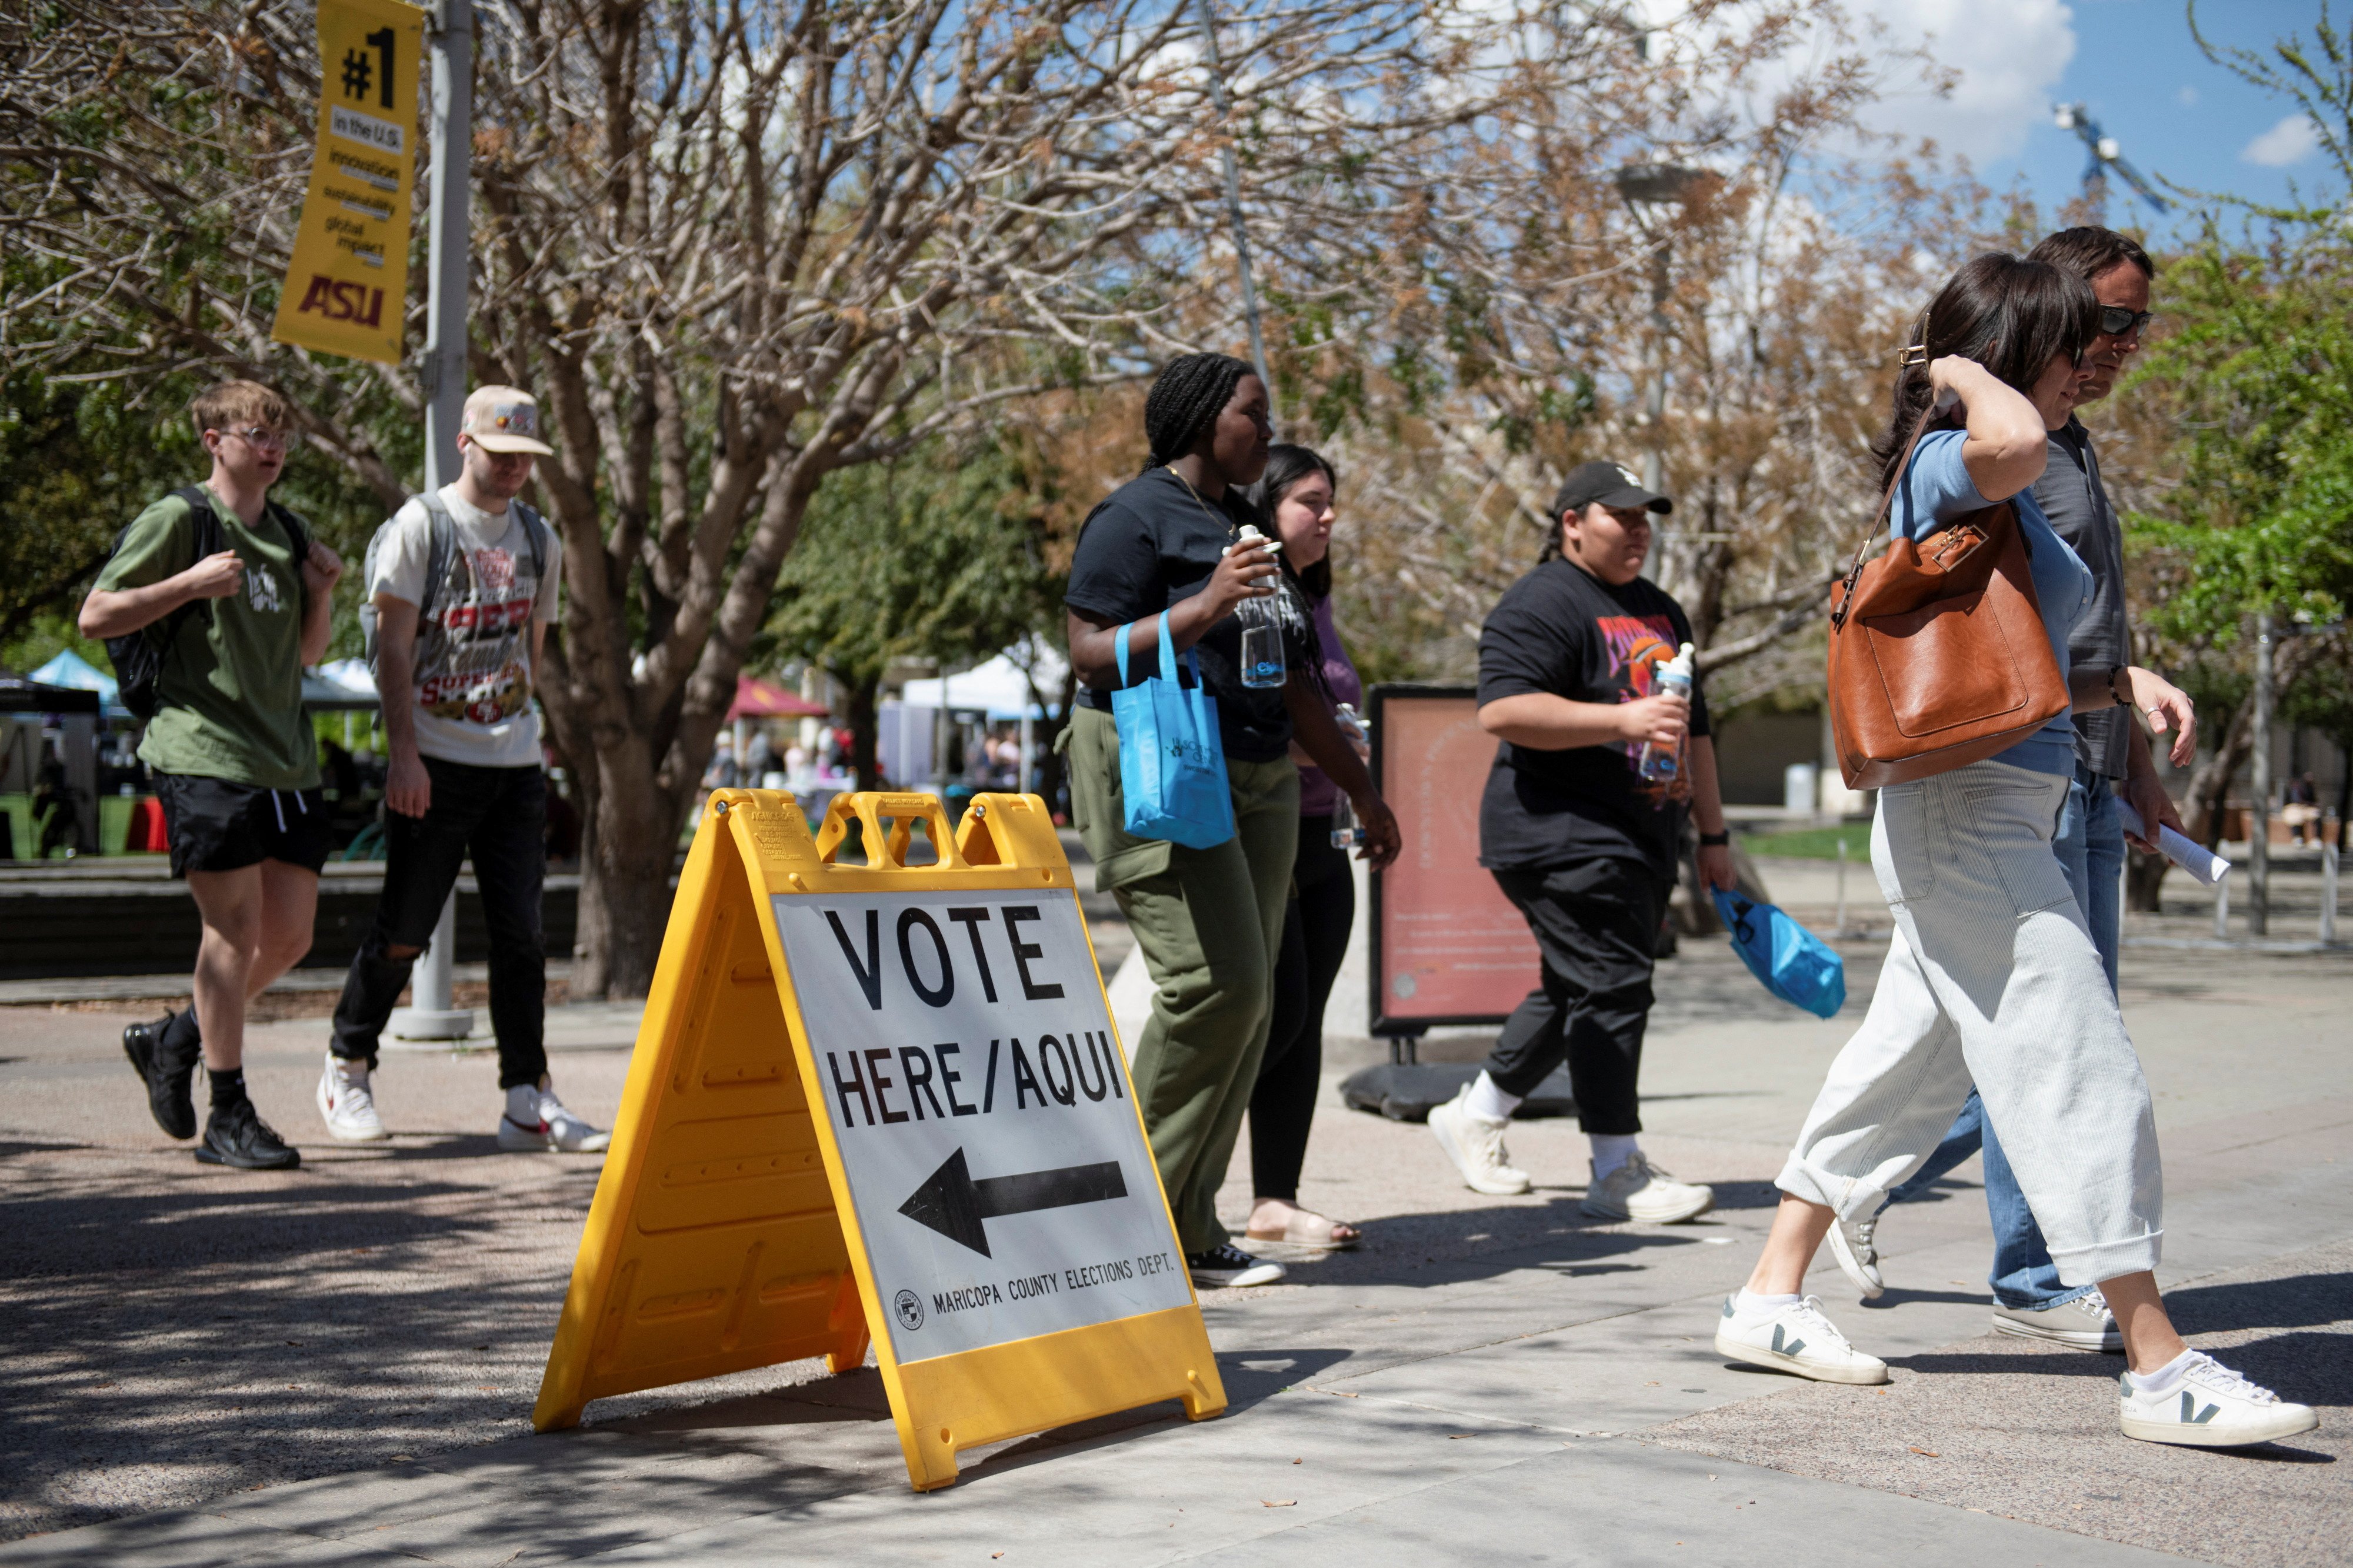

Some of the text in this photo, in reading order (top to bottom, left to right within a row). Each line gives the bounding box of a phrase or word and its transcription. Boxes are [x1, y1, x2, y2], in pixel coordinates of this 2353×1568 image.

[341, 27, 395, 110] #1
[334, 110, 348, 133] in
[350, 117, 372, 139] the
[298, 273, 384, 329] ASU
[824, 906, 1065, 1010] VOTE
[826, 1030, 1124, 1128] HERE/AQUI
[896, 1292, 916, 1306] MARICOPA
[932, 1252, 1175, 1315] MARICOPA COUNTY ELECTIONS DEPT.
[903, 1318, 922, 1328] COUNTY
